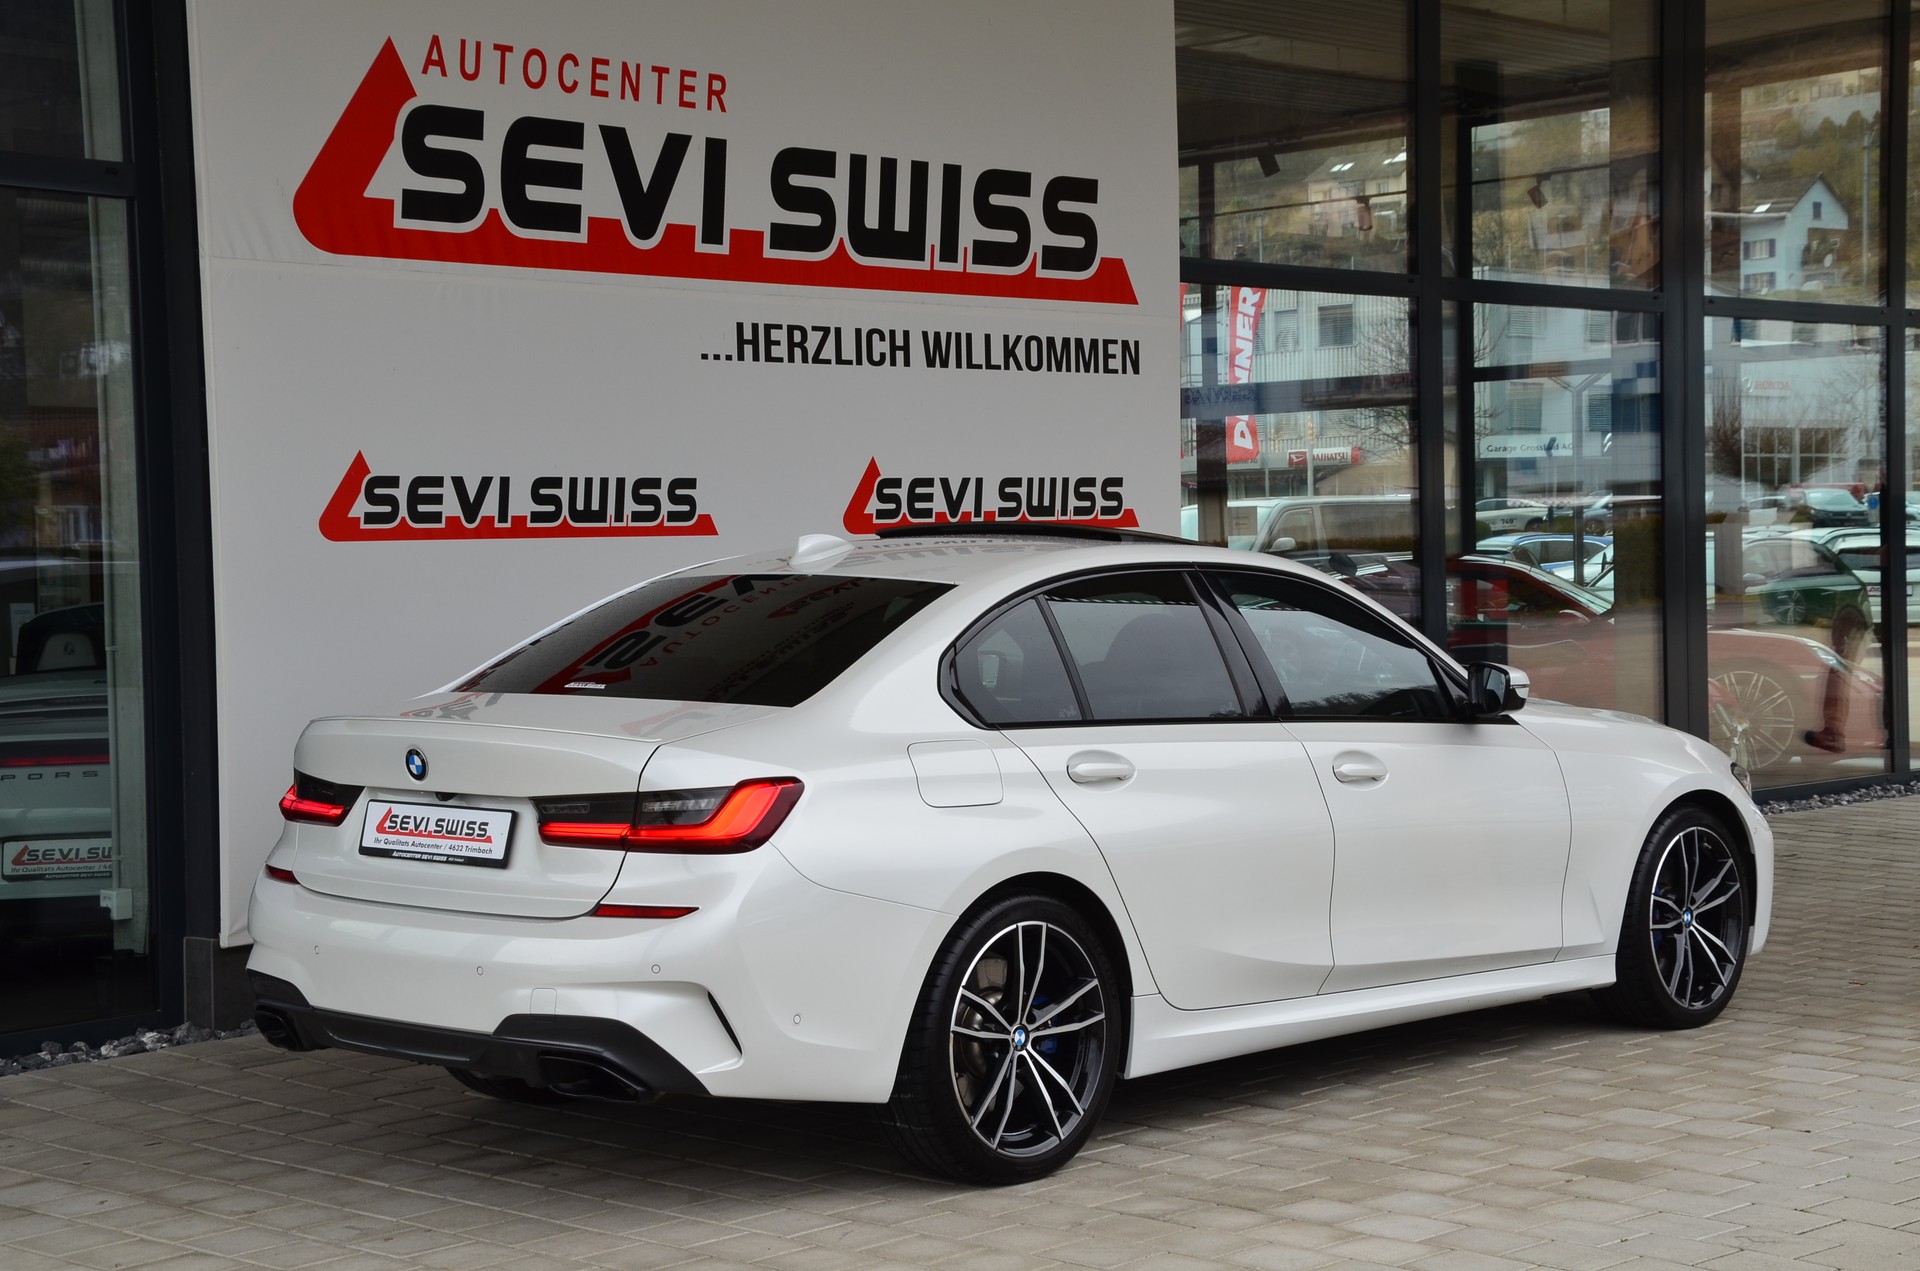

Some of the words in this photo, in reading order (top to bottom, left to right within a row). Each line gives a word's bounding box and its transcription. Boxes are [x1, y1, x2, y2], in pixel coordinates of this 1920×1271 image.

[421, 34, 728, 113] AUTOCENTER
[401, 104, 728, 246] SEVI
[769, 146, 1099, 272] SWISS
[921, 330, 1141, 375] WILLKOMMEN
[1486, 445, 1517, 454] Garage
[363, 475, 511, 525] SEVI
[529, 476, 698, 524] SWISS
[875, 477, 984, 520] SEVI
[997, 476, 1124, 518] SWISS
[387, 814, 430, 833] SEVI
[433, 818, 489, 837] SWISS
[27, 848, 79, 861] SEVI
[410, 841, 443, 850] Autocenter
[448, 844, 464, 852] 4632
[465, 845, 493, 855] Trimbach
[56, 864, 96, 872] Autocenter
